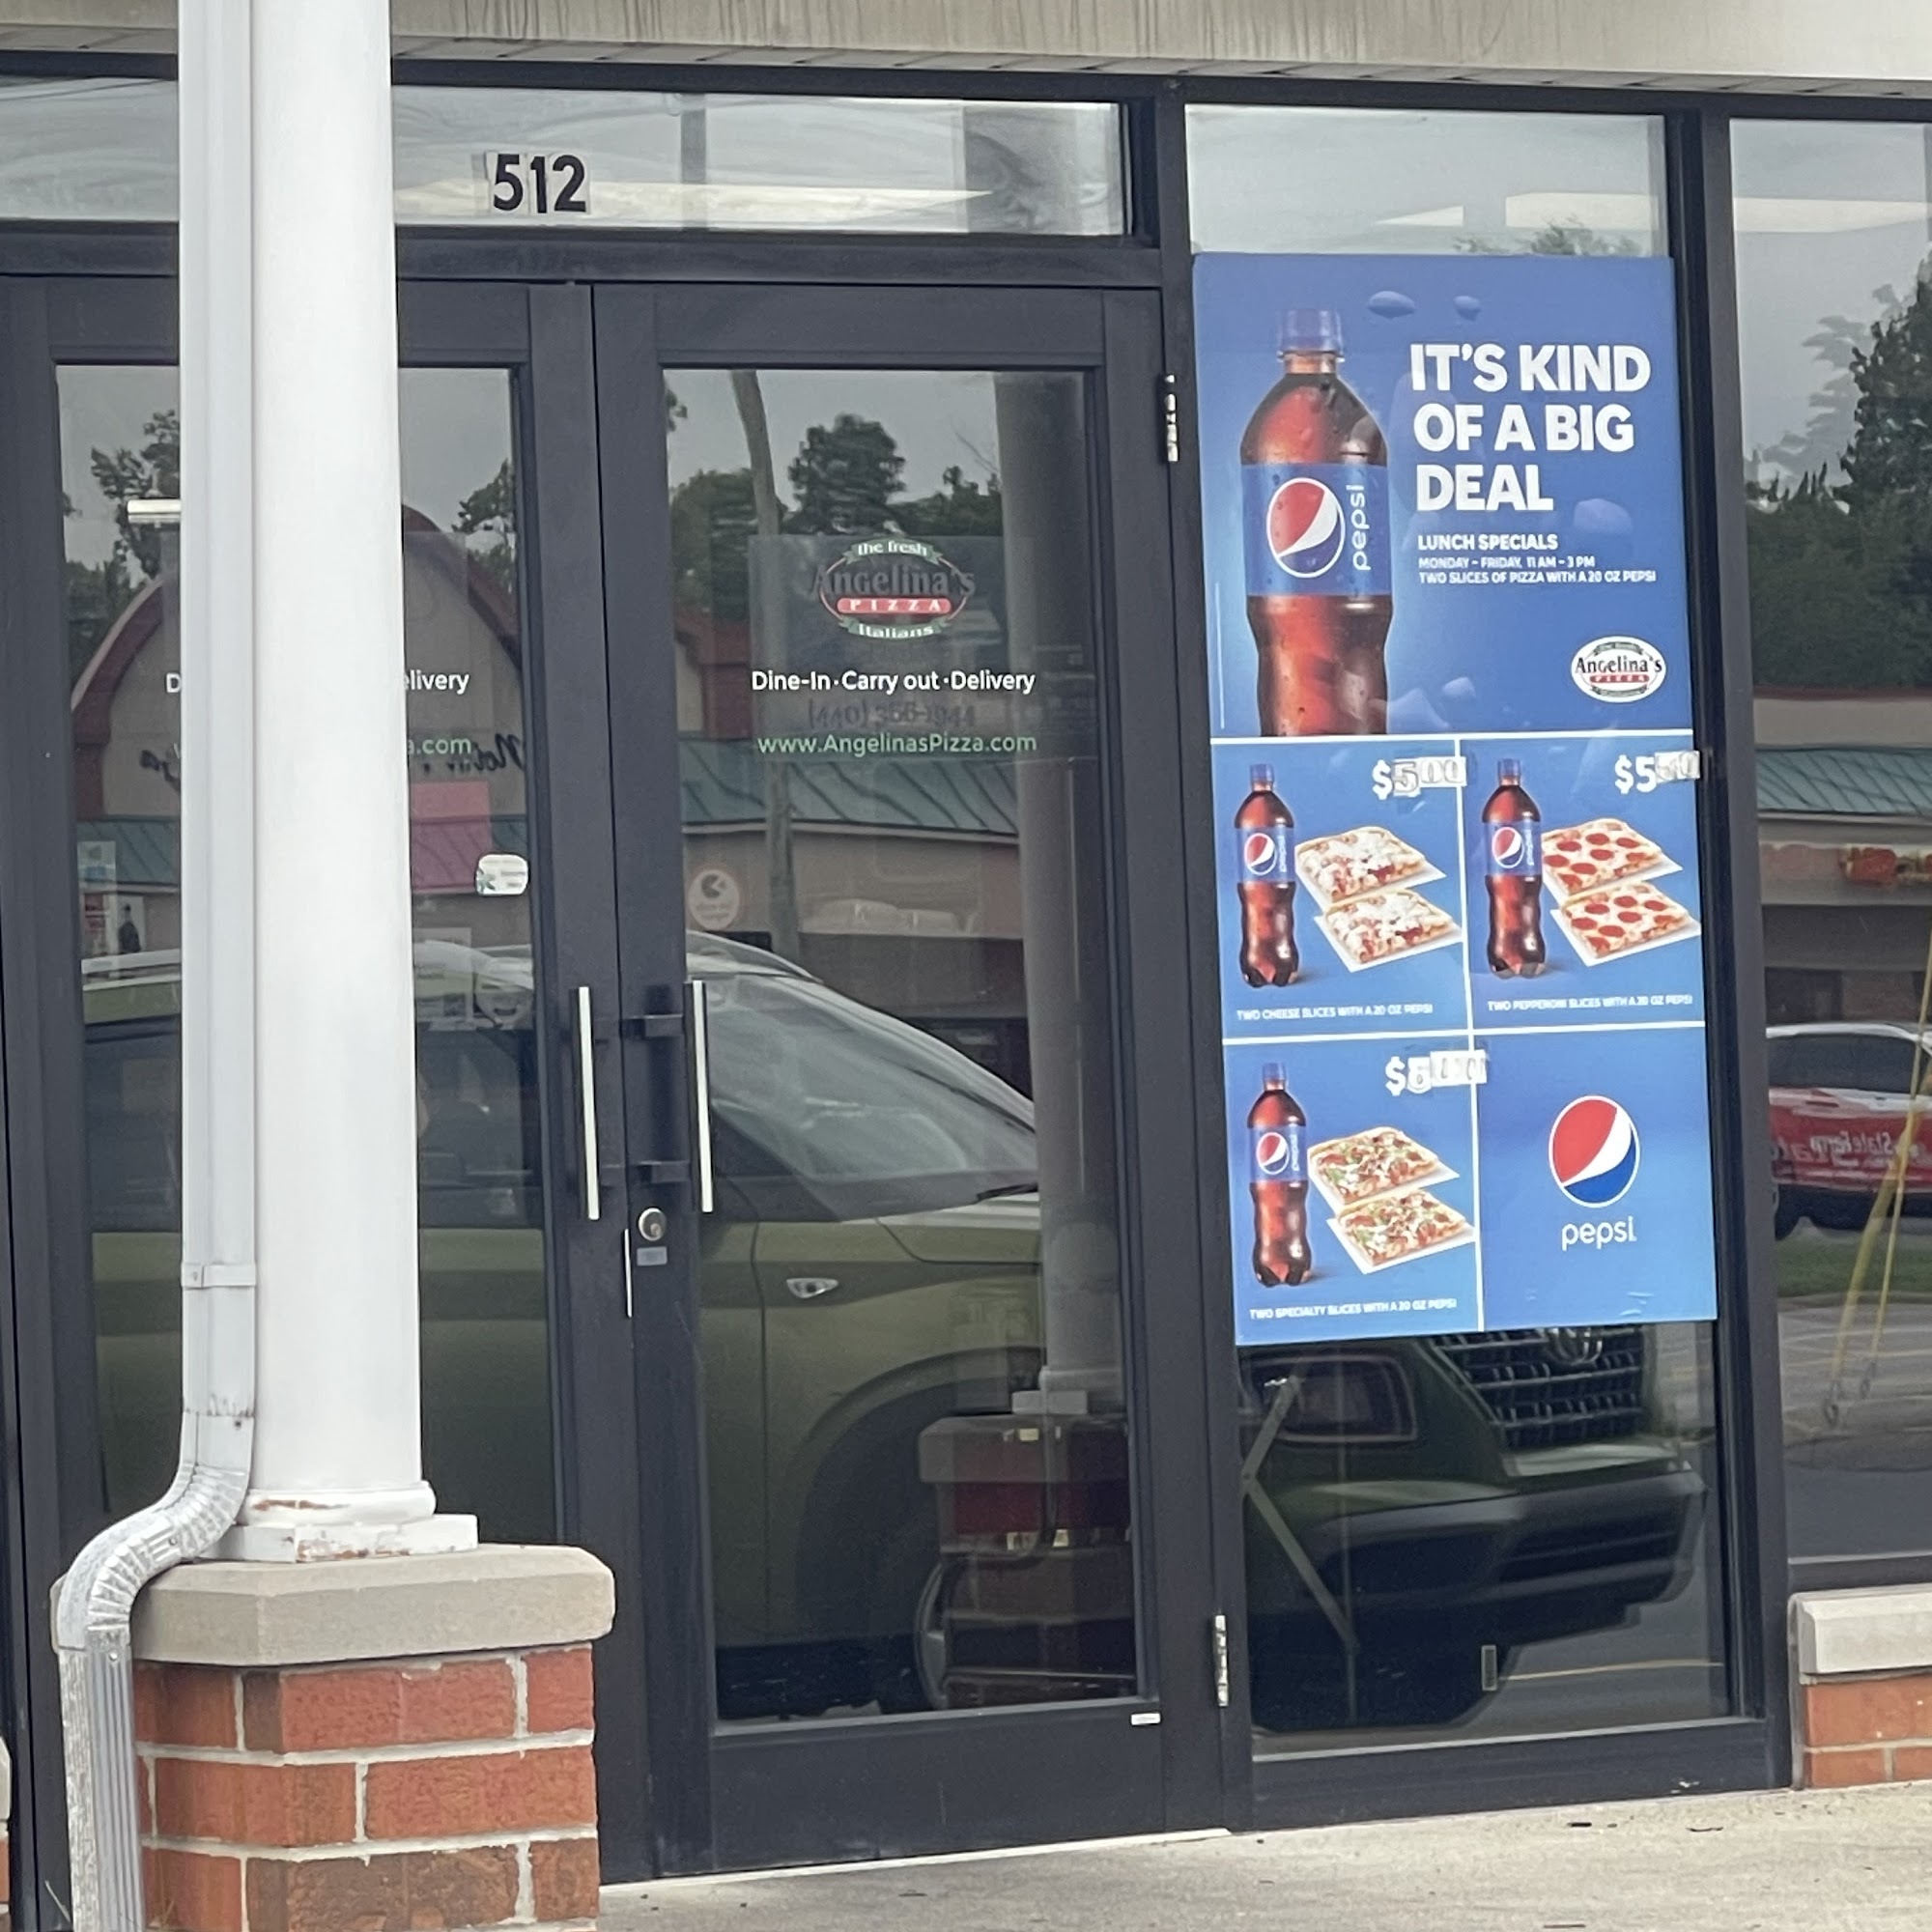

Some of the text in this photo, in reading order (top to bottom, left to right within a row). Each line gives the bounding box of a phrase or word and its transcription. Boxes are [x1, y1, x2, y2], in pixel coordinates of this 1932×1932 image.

[494, 153, 587, 214] 512
[1410, 343, 1652, 392] IT'S KIND
[1413, 403, 1634, 452] OF A BIG
[1416, 464, 1554, 511] DEAL
[1346, 484, 1372, 571] pepsi
[858, 540, 928, 556] the fresh
[1417, 533, 1559, 551] LUNCH SPECIALS
[1418, 556, 1469, 569] MONDAY
[1526, 555, 1536, 568] 11
[1537, 555, 1557, 568] AM
[1567, 555, 1575, 568] 3
[1576, 555, 1595, 568] PM
[1419, 572, 1447, 584] TWO
[1449, 571, 1490, 583] SLICES
[1491, 571, 1507, 583] OF
[1509, 571, 1546, 583] PIZZA
[1546, 571, 1577, 583] WITH
[1578, 570, 1588, 582] A
[1604, 570, 1621, 582] OZ
[1623, 570, 1657, 582] PEPSI
[849, 598, 942, 612] PIZZA
[858, 623, 934, 639] Italians
[752, 669, 1036, 696] Dine-In Carry out Delivery
[757, 731, 1037, 758] www.AngelinasPizza.com
[1236, 1009, 1260, 1021] TWO
[1262, 1008, 1300, 1020] CHEESE
[1302, 1007, 1336, 1019] SLICES
[1337, 1006, 1364, 1017] WITH
[1387, 1004, 1402, 1015] OZ
[1404, 1003, 1434, 1014] PEPSI
[1488, 1000, 1511, 1011] TWO
[1569, 997, 1601, 1009] SLICES
[1603, 996, 1628, 1008] WITH
[1561, 1215, 1637, 1252] pepsi
[1250, 1309, 1273, 1321] TWO
